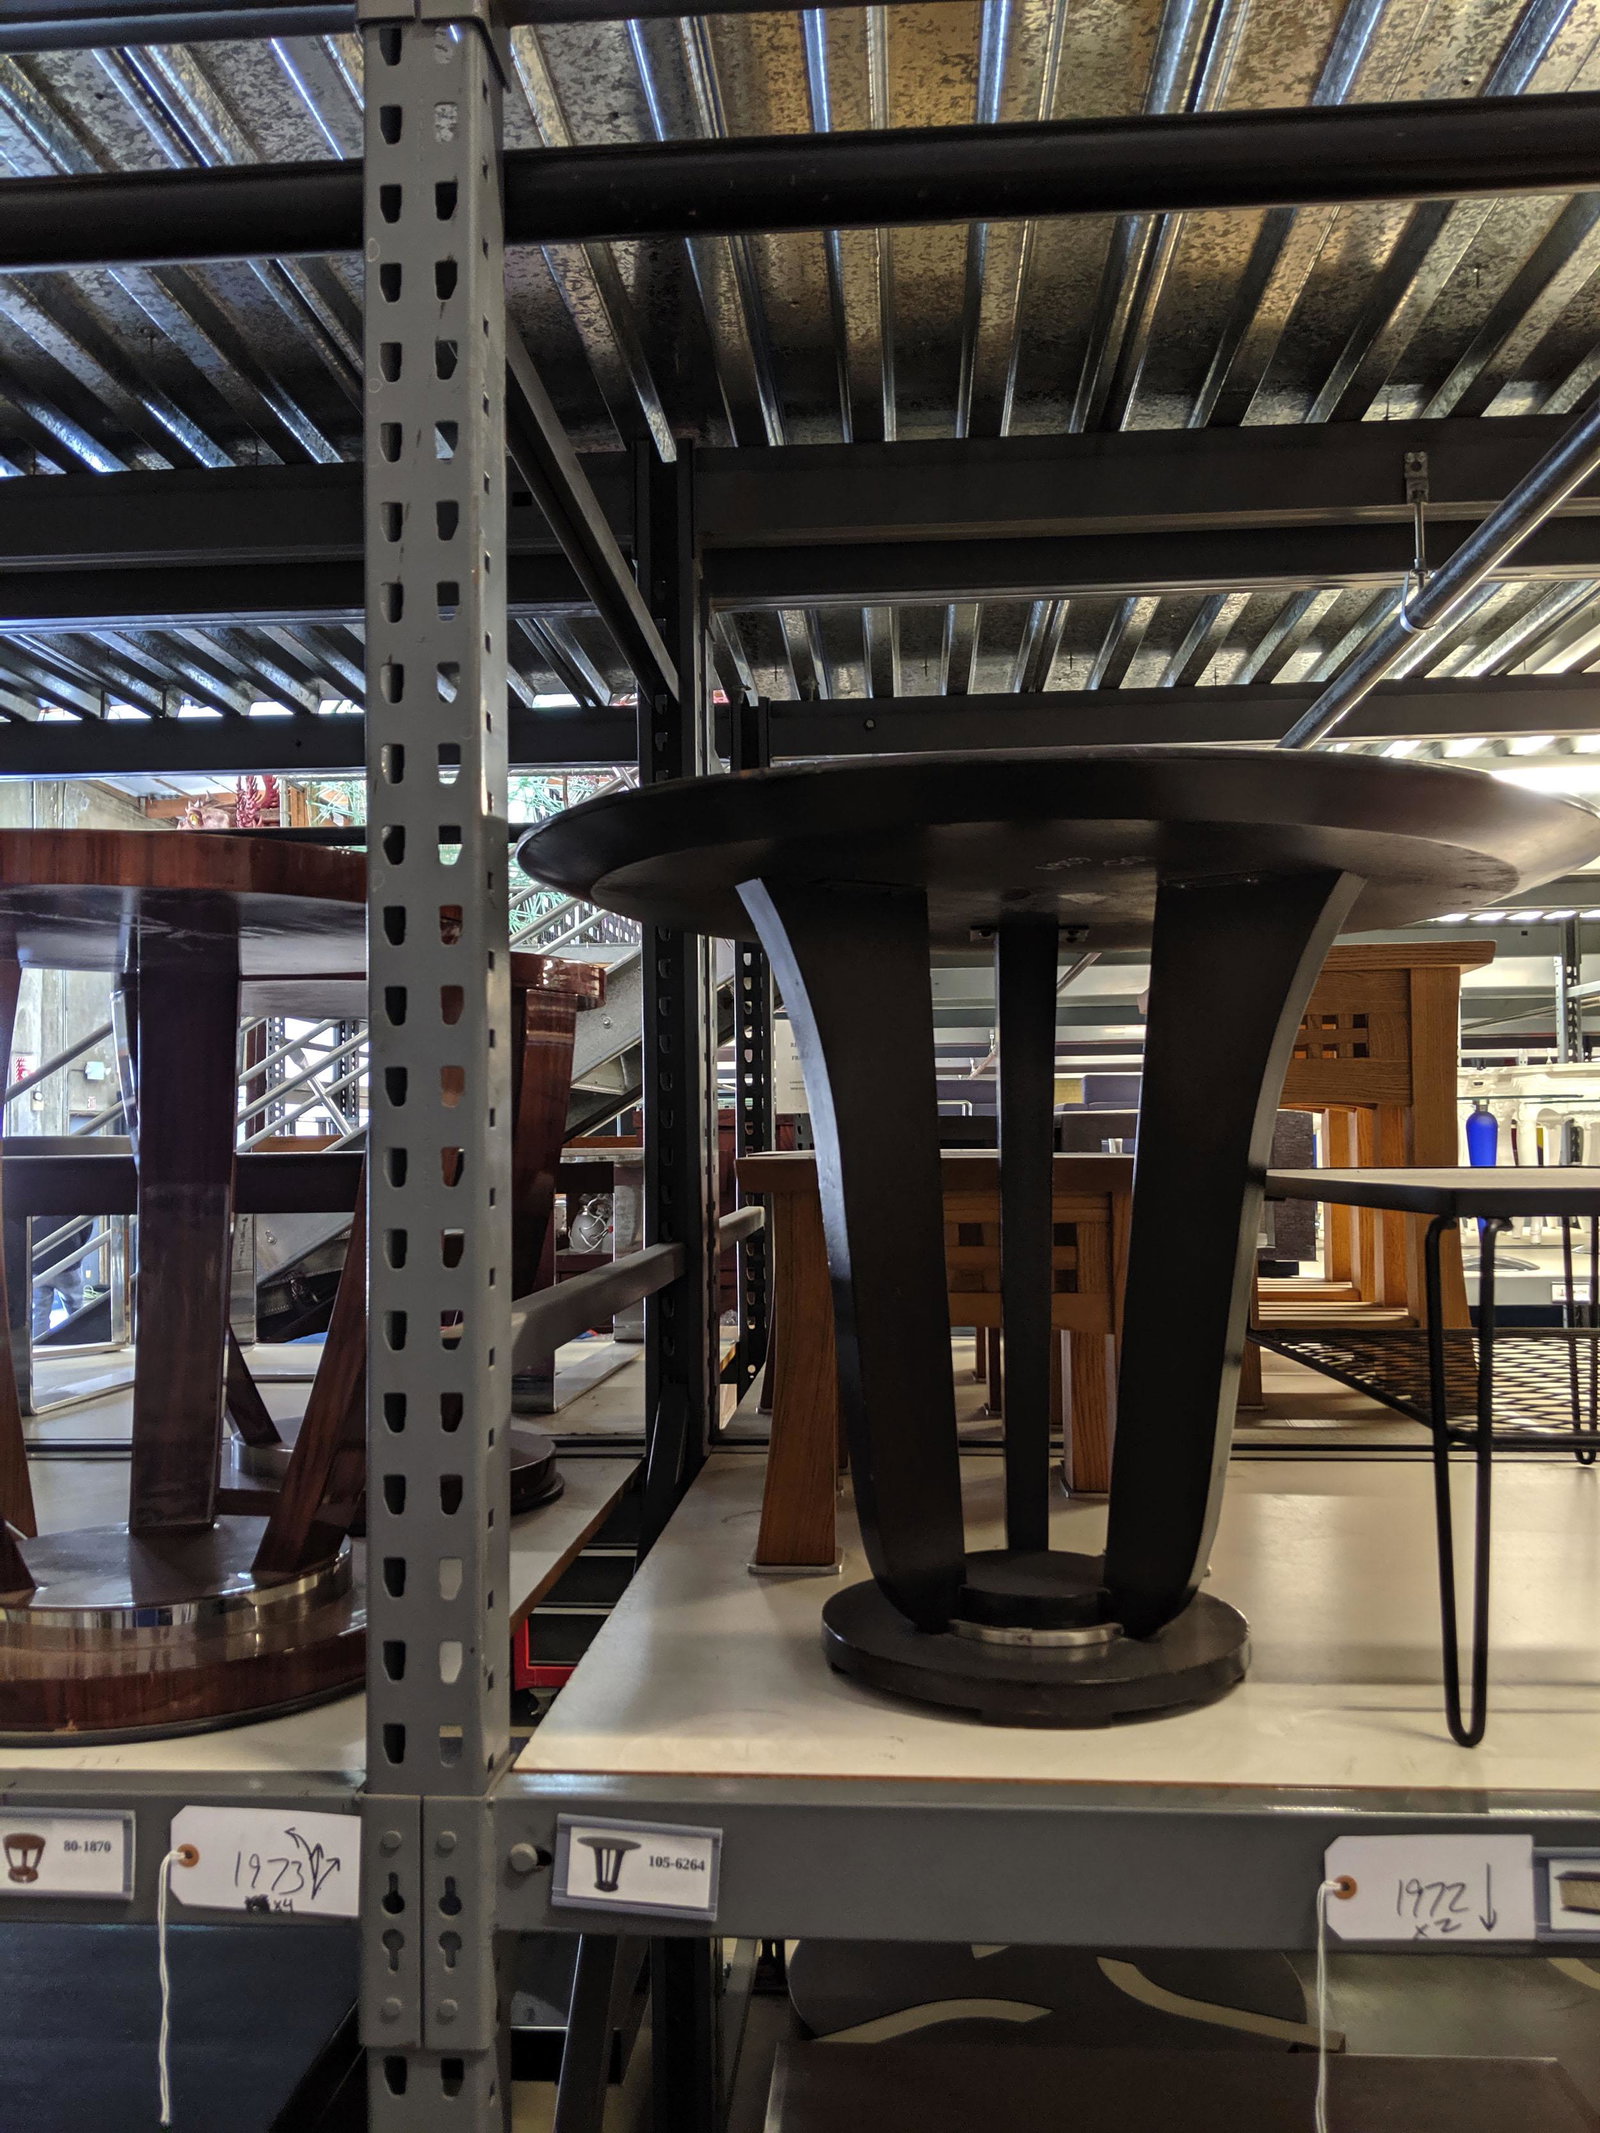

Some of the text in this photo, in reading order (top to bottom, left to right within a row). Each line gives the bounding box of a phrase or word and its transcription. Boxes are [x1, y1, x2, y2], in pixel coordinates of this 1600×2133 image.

[63, 1839, 111, 1852] 80-1870
[234, 1851, 305, 1895] 1973
[649, 1855, 705, 1871] 105-6264
[1397, 1878, 1469, 1917] 1972
